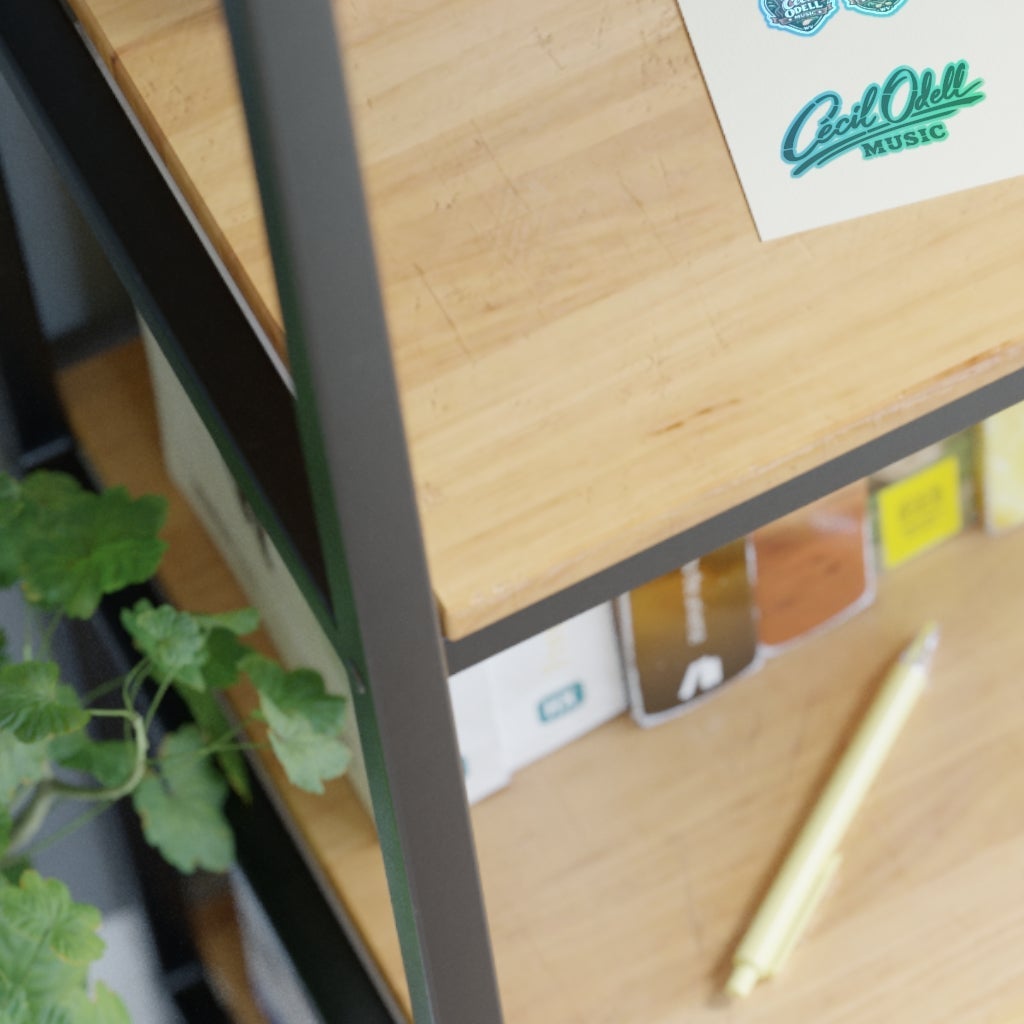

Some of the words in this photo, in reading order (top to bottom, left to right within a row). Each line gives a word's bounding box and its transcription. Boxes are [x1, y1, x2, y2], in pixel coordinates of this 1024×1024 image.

[784, 1, 823, 18] ODELL
[794, 10, 816, 19] MUSIC
[783, 85, 878, 162] Cecil
[880, 63, 983, 123] Odell
[861, 123, 947, 157] MUSIC
